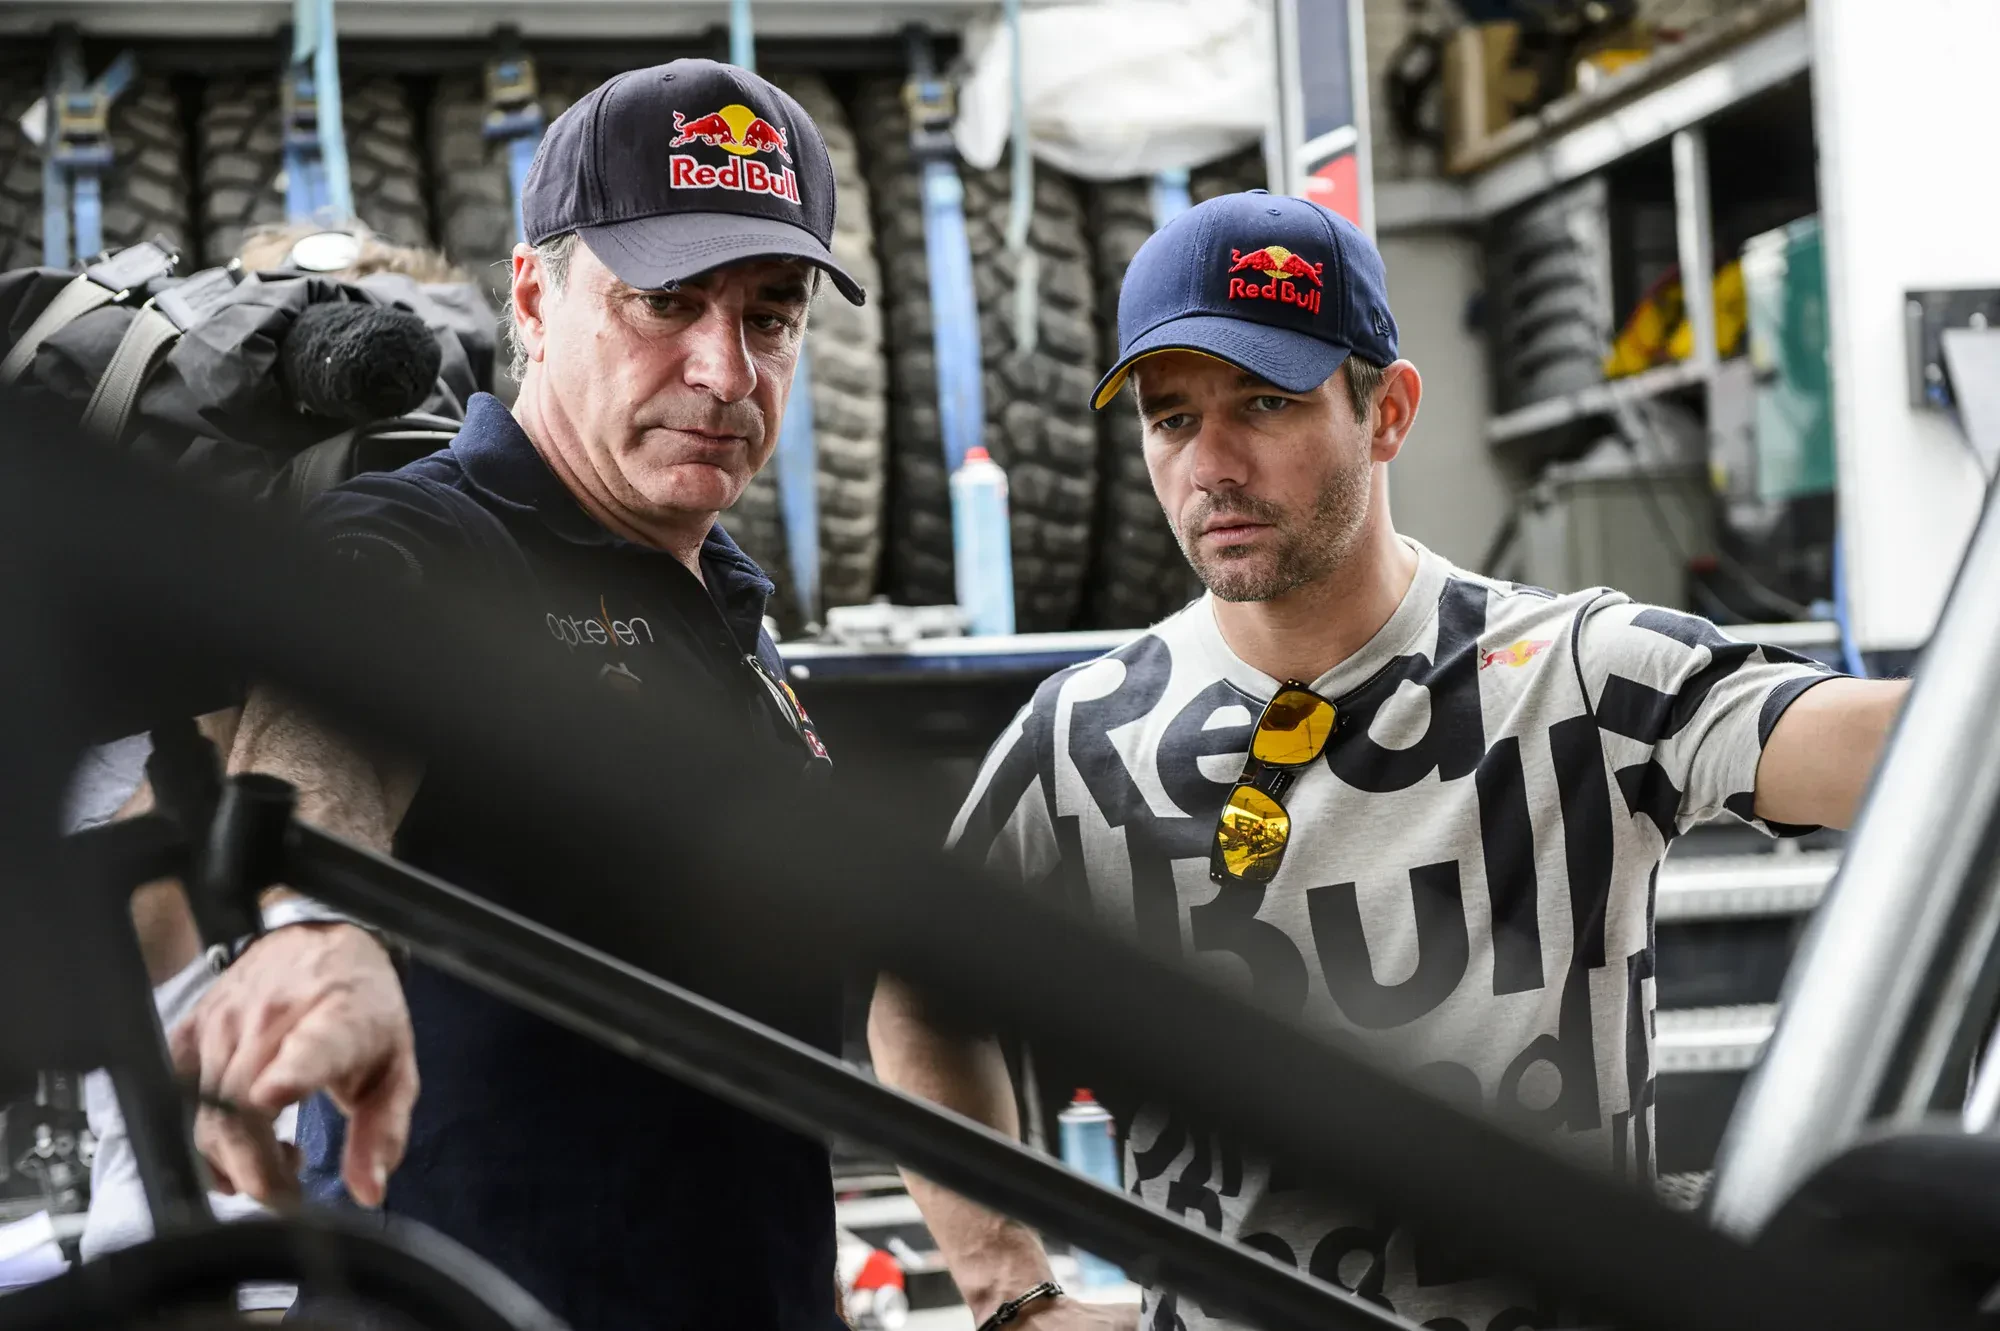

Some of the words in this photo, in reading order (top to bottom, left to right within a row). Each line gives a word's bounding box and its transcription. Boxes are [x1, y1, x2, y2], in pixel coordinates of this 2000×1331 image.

[670, 155, 743, 190] Red
[743, 159, 801, 205] Bull
[1229, 277, 1277, 300] Red
[1281, 281, 1320, 315] Bull
[1033, 577, 1488, 830] Red
[1125, 715, 1614, 1032] Bull
